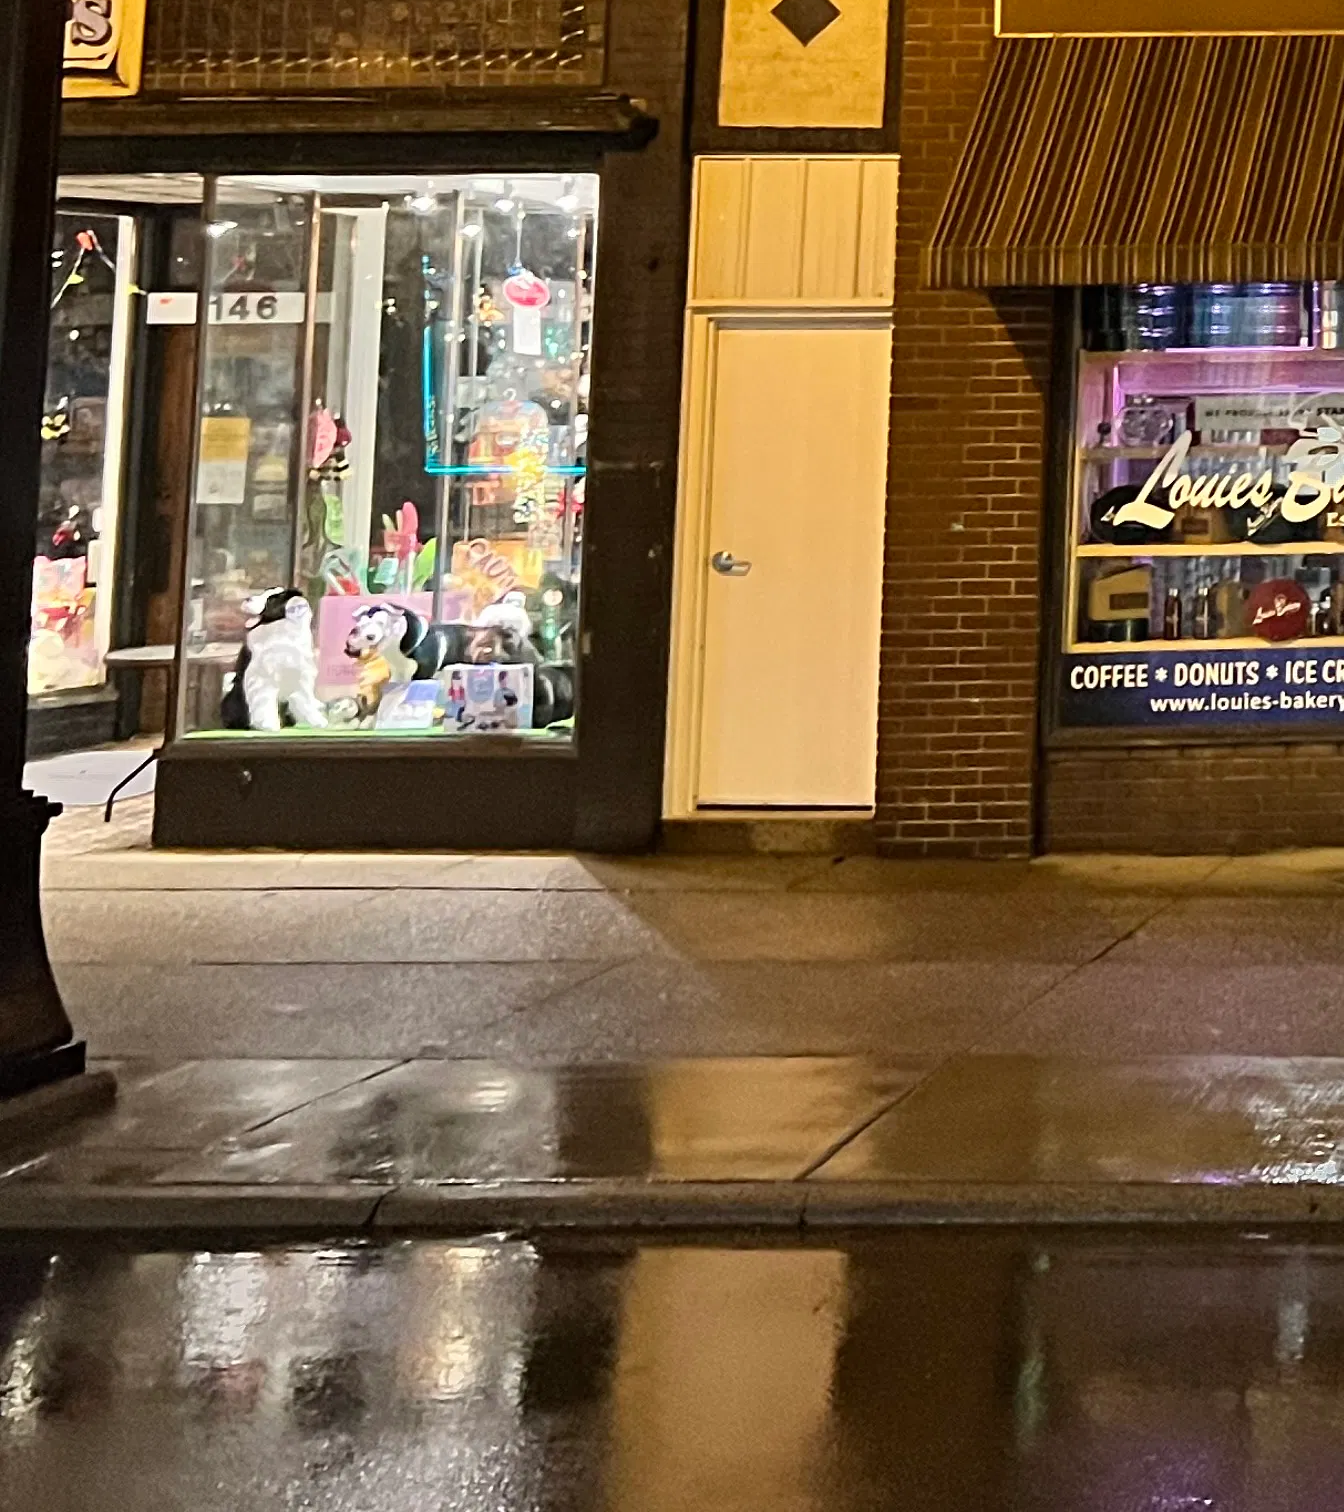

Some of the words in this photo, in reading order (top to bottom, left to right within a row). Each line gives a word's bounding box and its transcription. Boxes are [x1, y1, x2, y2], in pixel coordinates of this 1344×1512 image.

[209, 295, 278, 321] 146
[1113, 429, 1276, 529] Louies
[1070, 663, 1149, 690] COFFEE
[1174, 661, 1260, 687] DONUTS
[1285, 660, 1317, 685] ICE
